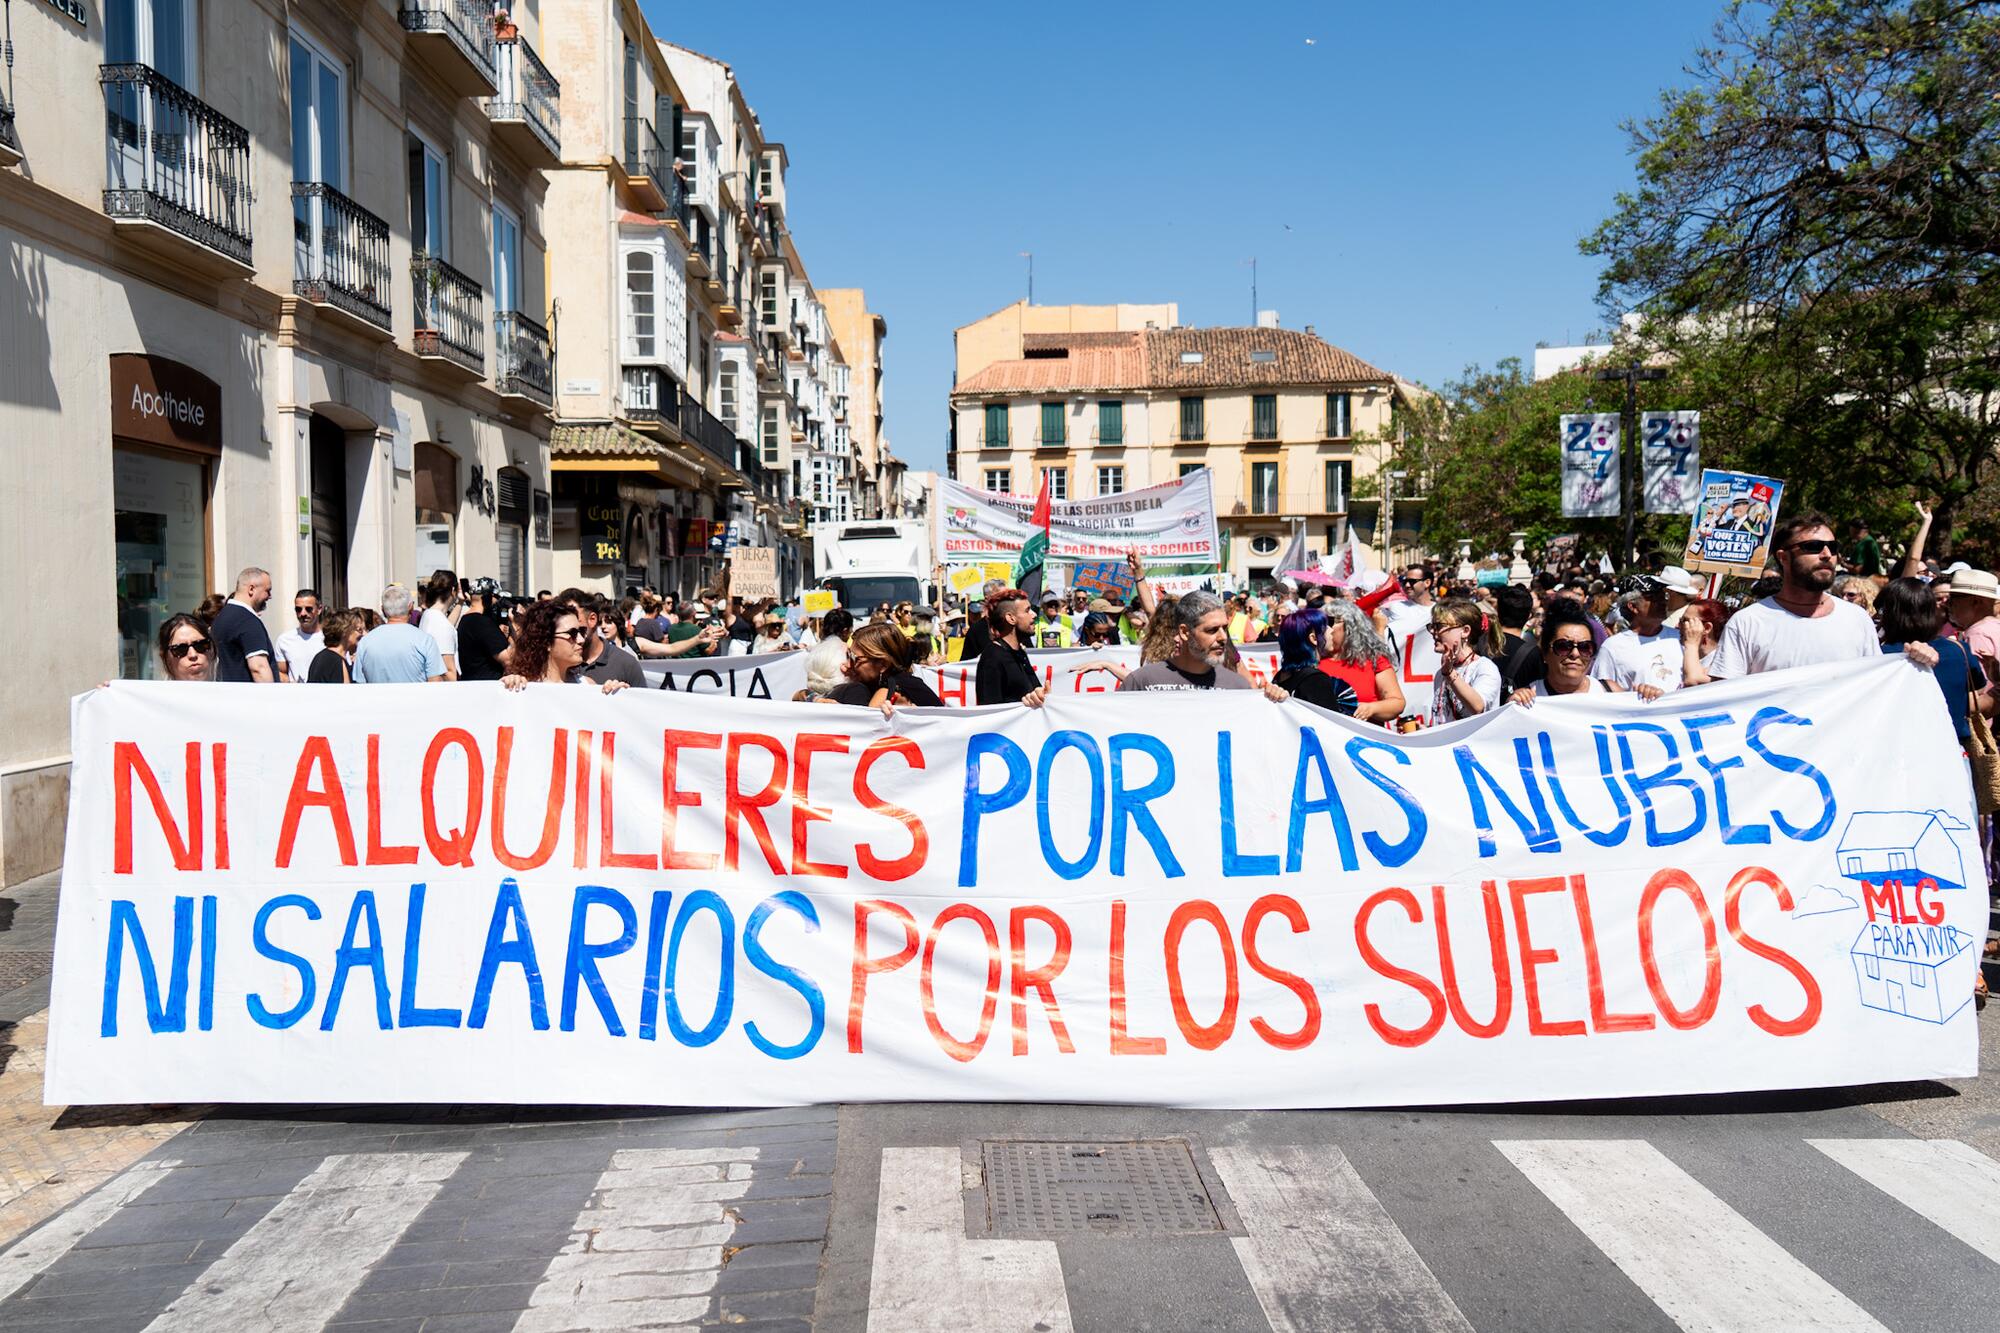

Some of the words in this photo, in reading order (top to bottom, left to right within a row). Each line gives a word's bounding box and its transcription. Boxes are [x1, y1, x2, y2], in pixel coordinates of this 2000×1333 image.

[131, 383, 205, 427] Apotheke
[1050, 507, 1061, 516] DE
[1064, 506, 1083, 516] LAS
[1085, 501, 1132, 516] CUENTAS
[1134, 499, 1148, 511] DE
[1149, 498, 1163, 509] LA
[1078, 519, 1116, 530] SOCIAL
[1119, 517, 1134, 528] YA!
[1714, 531, 1734, 541] QUE
[1735, 533, 1748, 542] TE
[735, 548, 770, 561] FUERA
[945, 539, 993, 551] GASTOS
[1064, 544, 1096, 555] PARA
[1151, 541, 1210, 555] SOCIALES
[1707, 541, 1751, 553] VOTEN
[1181, 581, 1193, 589] DE
[113, 741, 231, 875] NI
[274, 725, 929, 883] ALQUILERES
[957, 729, 1186, 888] POR
[1217, 725, 1430, 879] LAS
[1451, 706, 1838, 861] NUBES
[1861, 877, 1945, 926] MLG
[1870, 924, 1918, 958] PARA
[100, 893, 218, 1039] NI
[245, 876, 827, 1061] SALARIOS
[846, 898, 1077, 1063] POR
[1108, 892, 1323, 1057] LOS
[1353, 865, 1823, 1049] SUELOS
